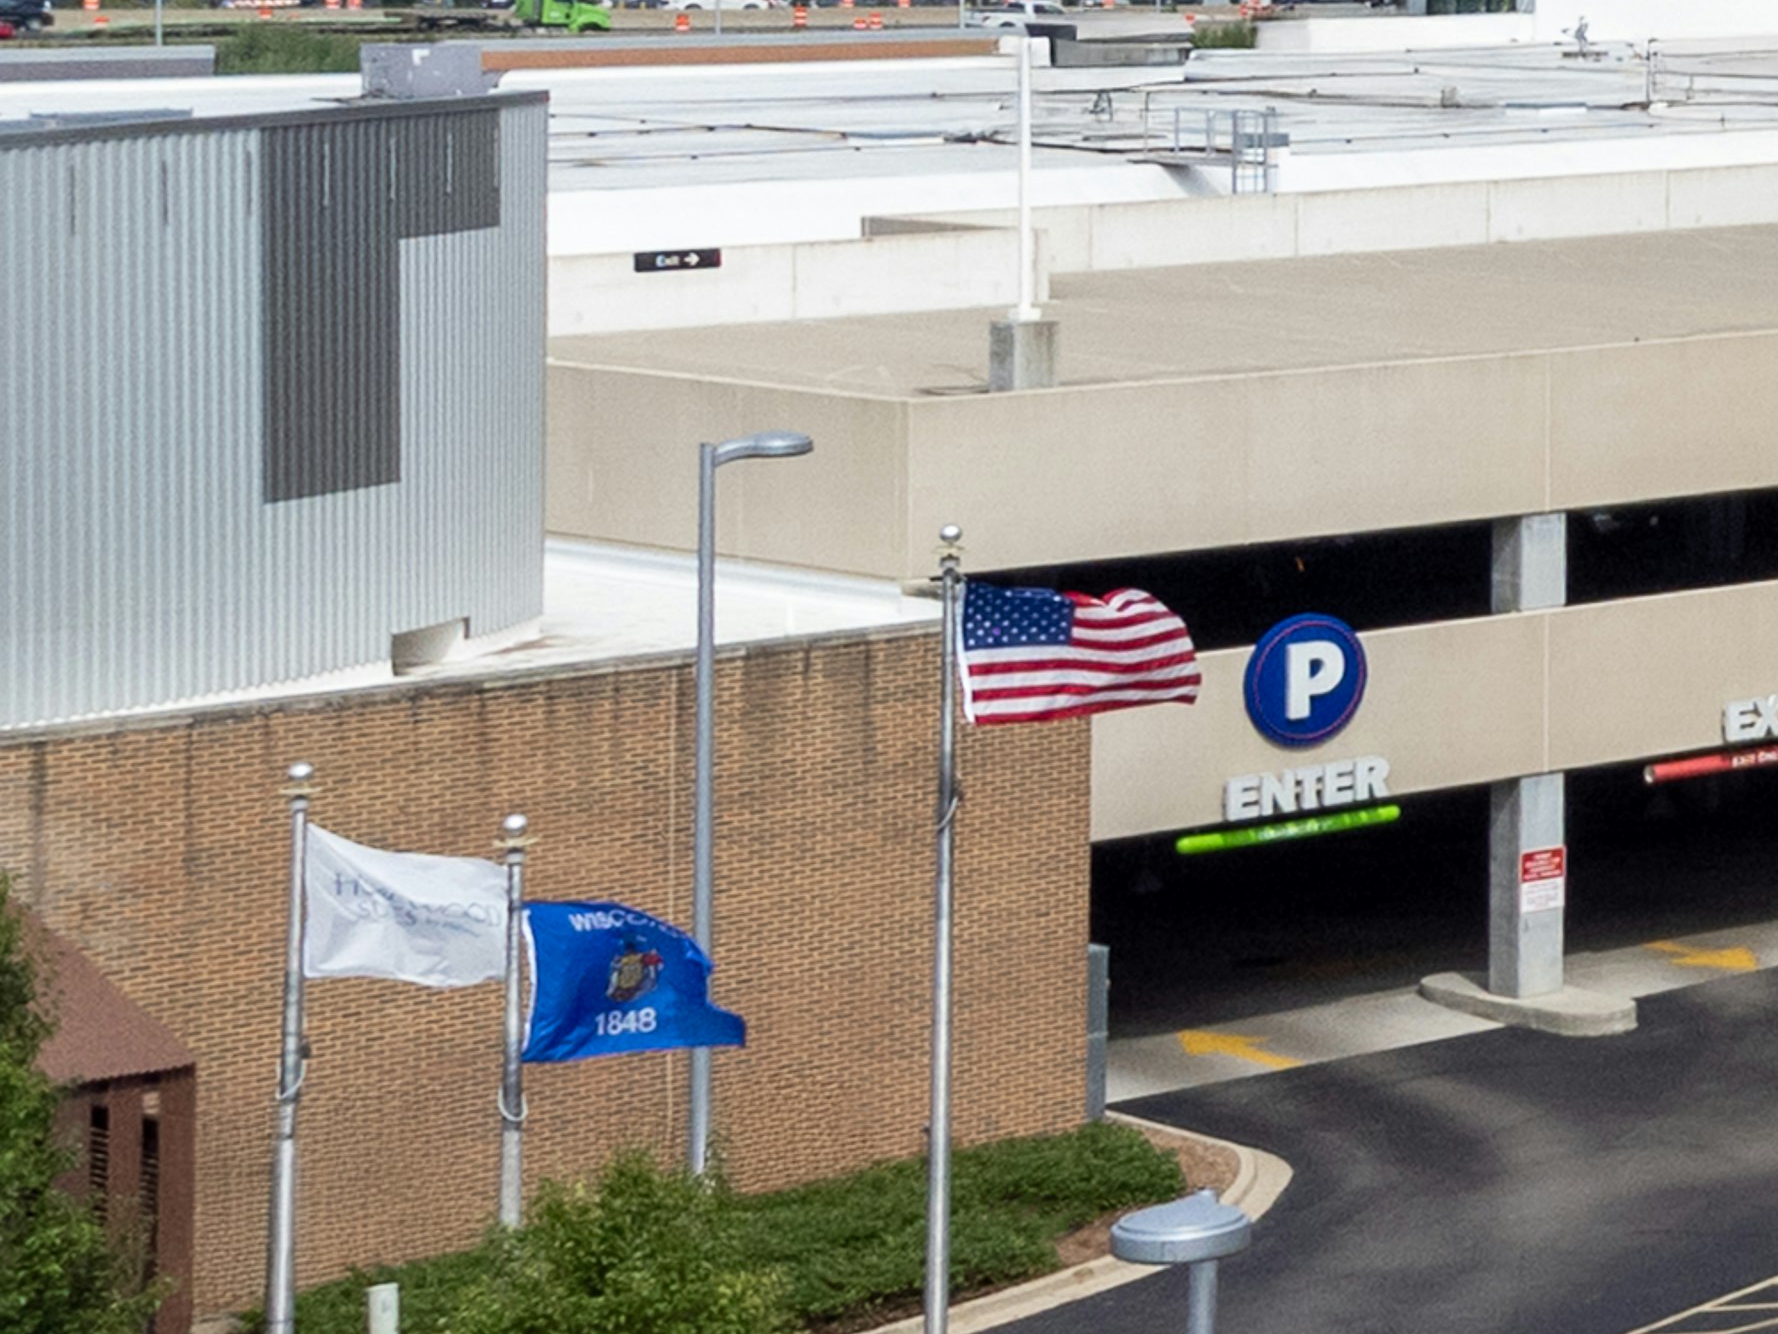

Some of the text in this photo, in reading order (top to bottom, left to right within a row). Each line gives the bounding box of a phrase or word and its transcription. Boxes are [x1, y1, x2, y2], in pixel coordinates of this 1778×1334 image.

[1286, 640, 1346, 720] P
[1224, 755, 1390, 822] ENTER
[595, 1007, 657, 1036] 1848
